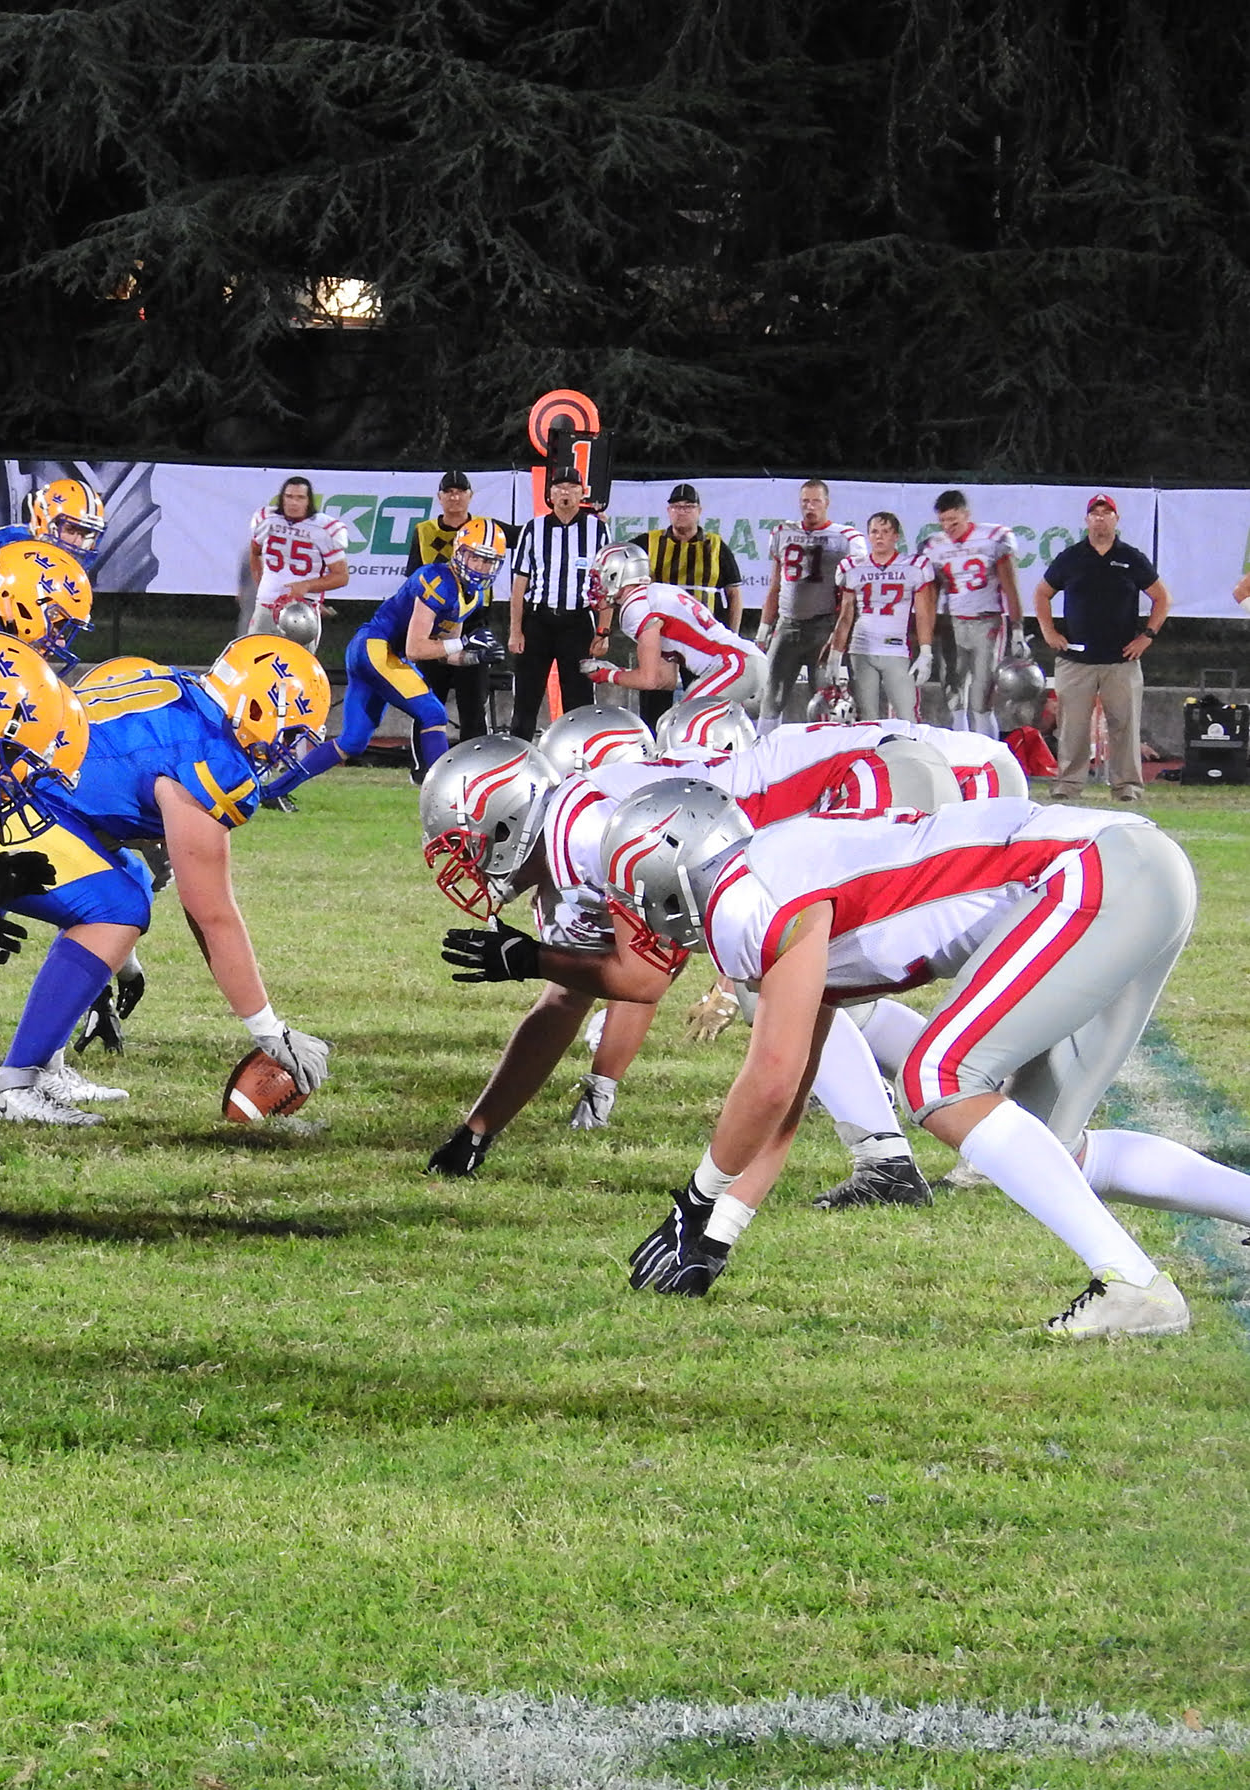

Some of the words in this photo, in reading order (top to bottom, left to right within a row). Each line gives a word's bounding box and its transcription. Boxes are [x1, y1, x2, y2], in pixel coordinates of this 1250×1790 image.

[571, 440, 592, 498] 1
[268, 524, 312, 539] AUSTRIA
[265, 535, 314, 577] 55
[347, 565, 408, 576] OGETHE
[784, 543, 824, 583] 81
[859, 571, 907, 583] AUSTRIA
[941, 557, 988, 595] 13
[860, 583, 905, 616] 17
